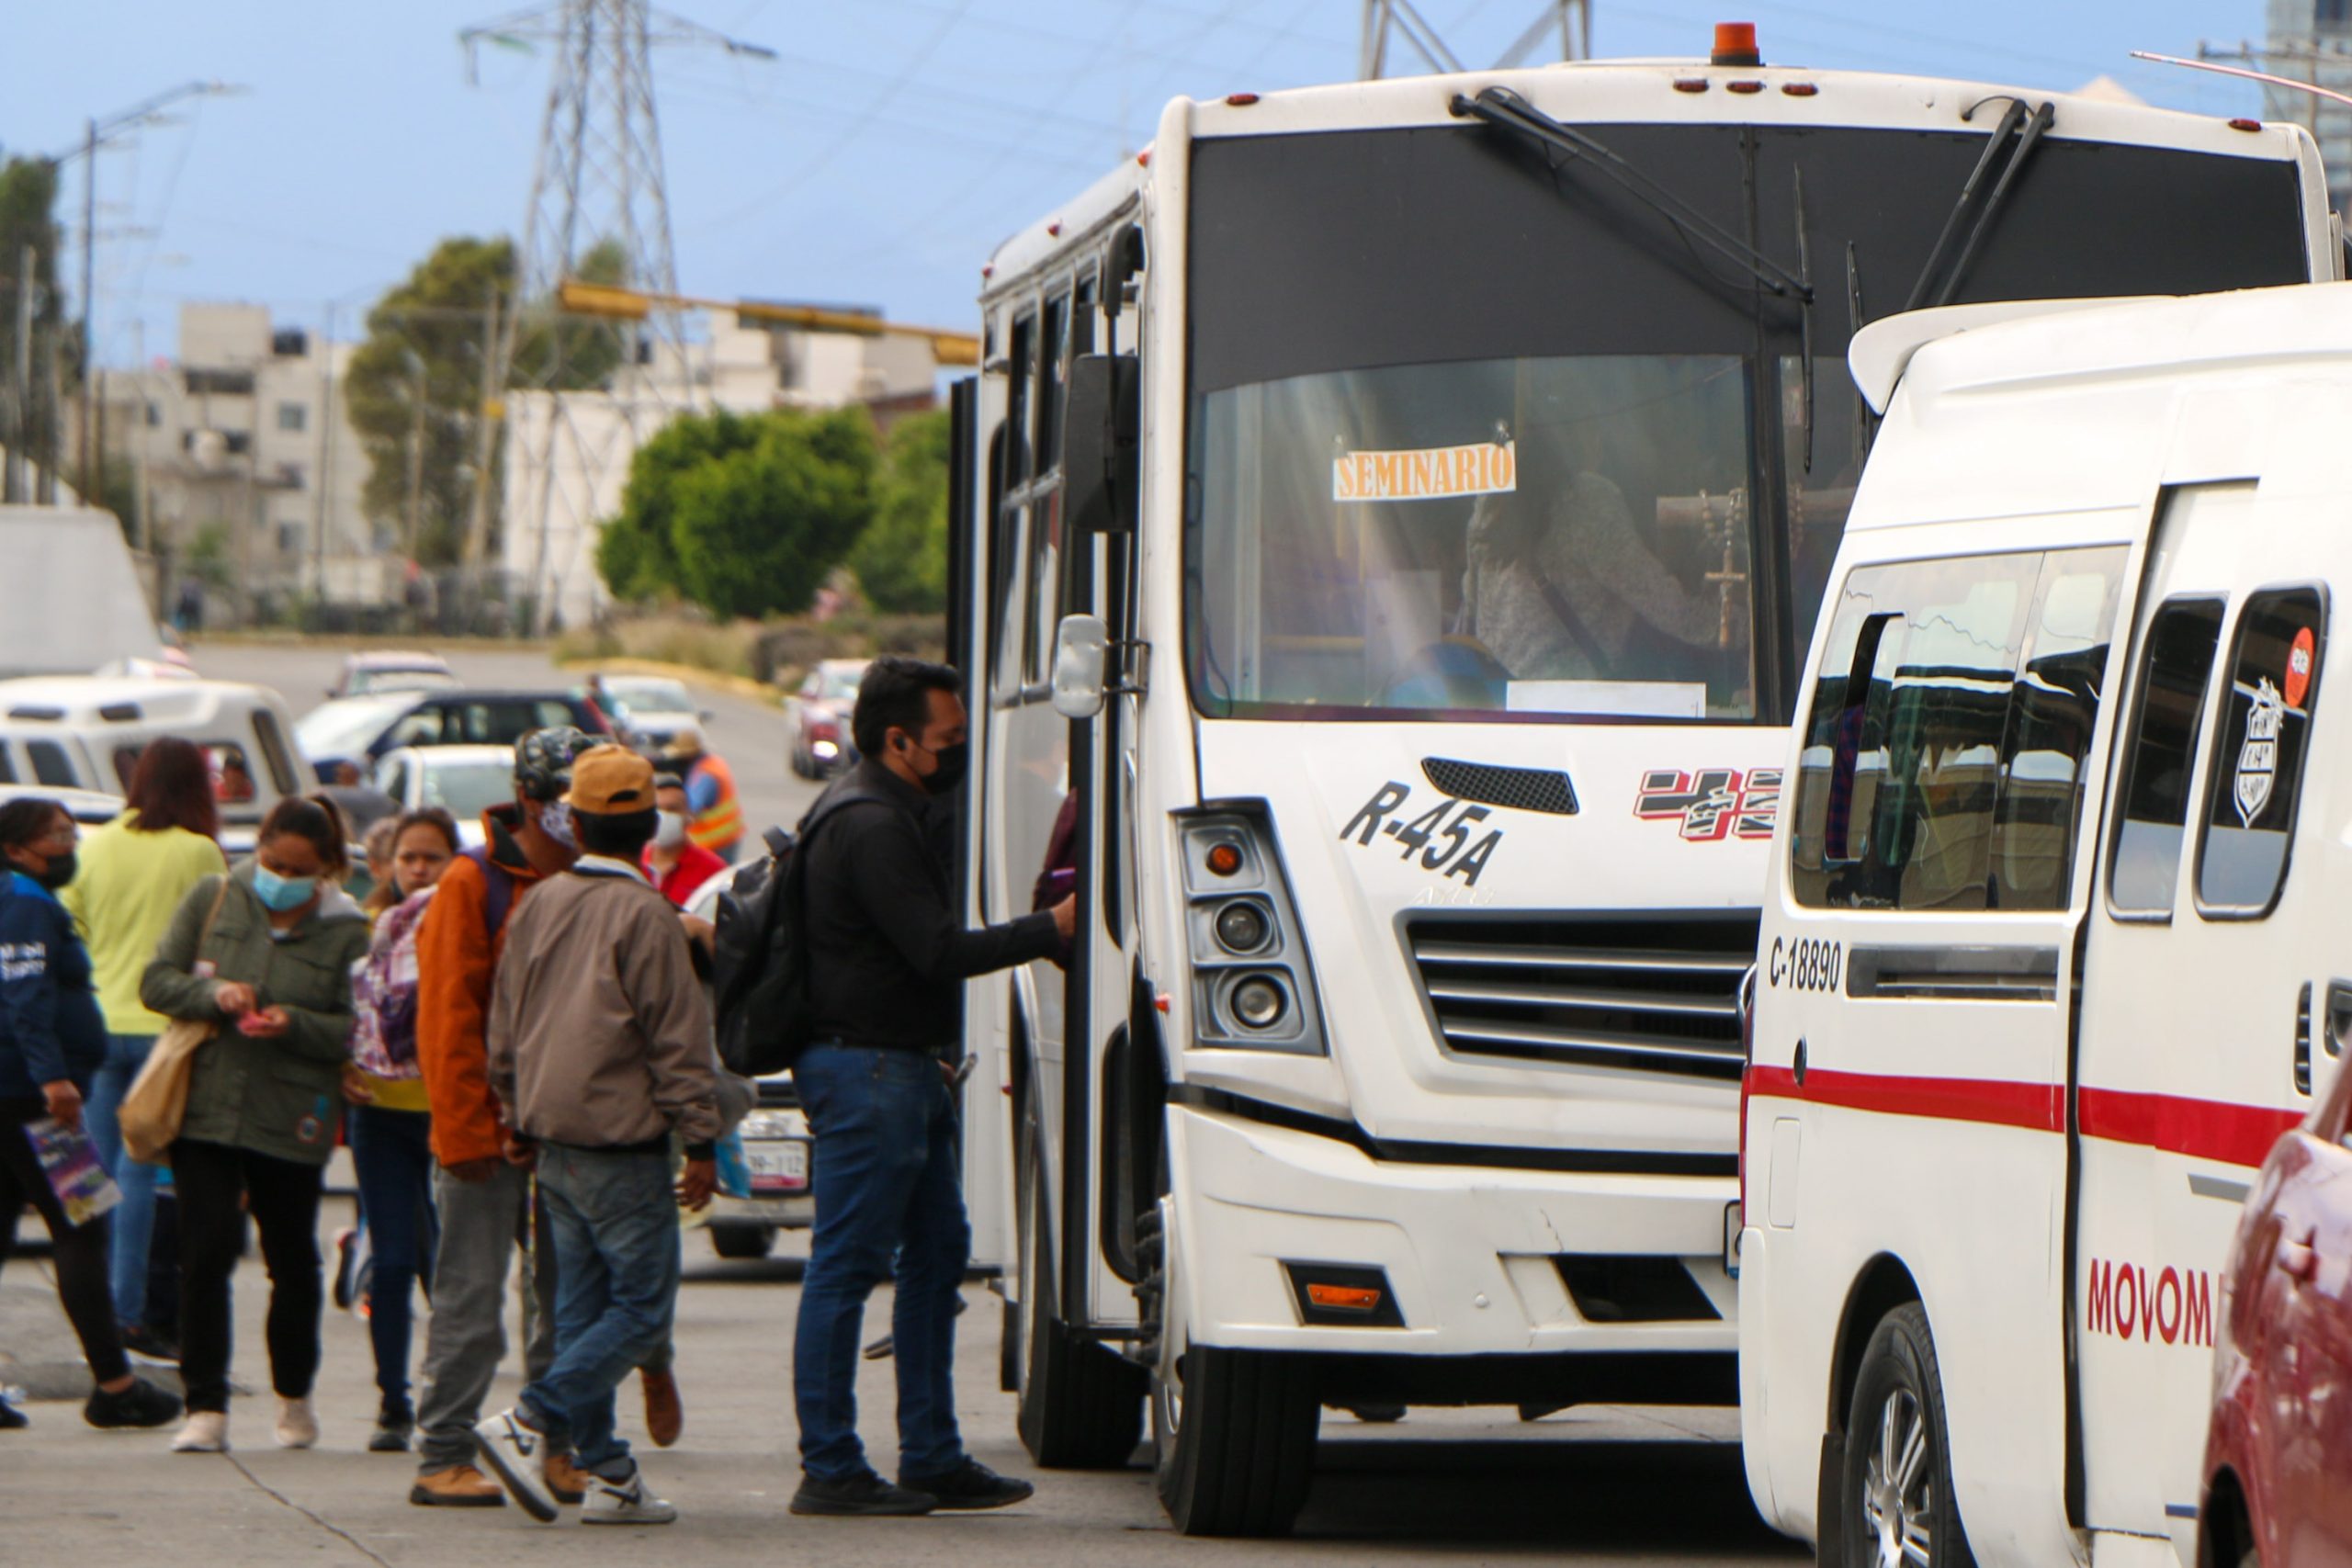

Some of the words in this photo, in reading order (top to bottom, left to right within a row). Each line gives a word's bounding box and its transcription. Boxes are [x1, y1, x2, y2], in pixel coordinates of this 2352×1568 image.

[1338, 445, 1513, 497] SEMINARIO
[1340, 781, 1503, 886] R-45A
[1770, 936, 1841, 993] C-18890
[2087, 1258, 2222, 1348] MOVOM
